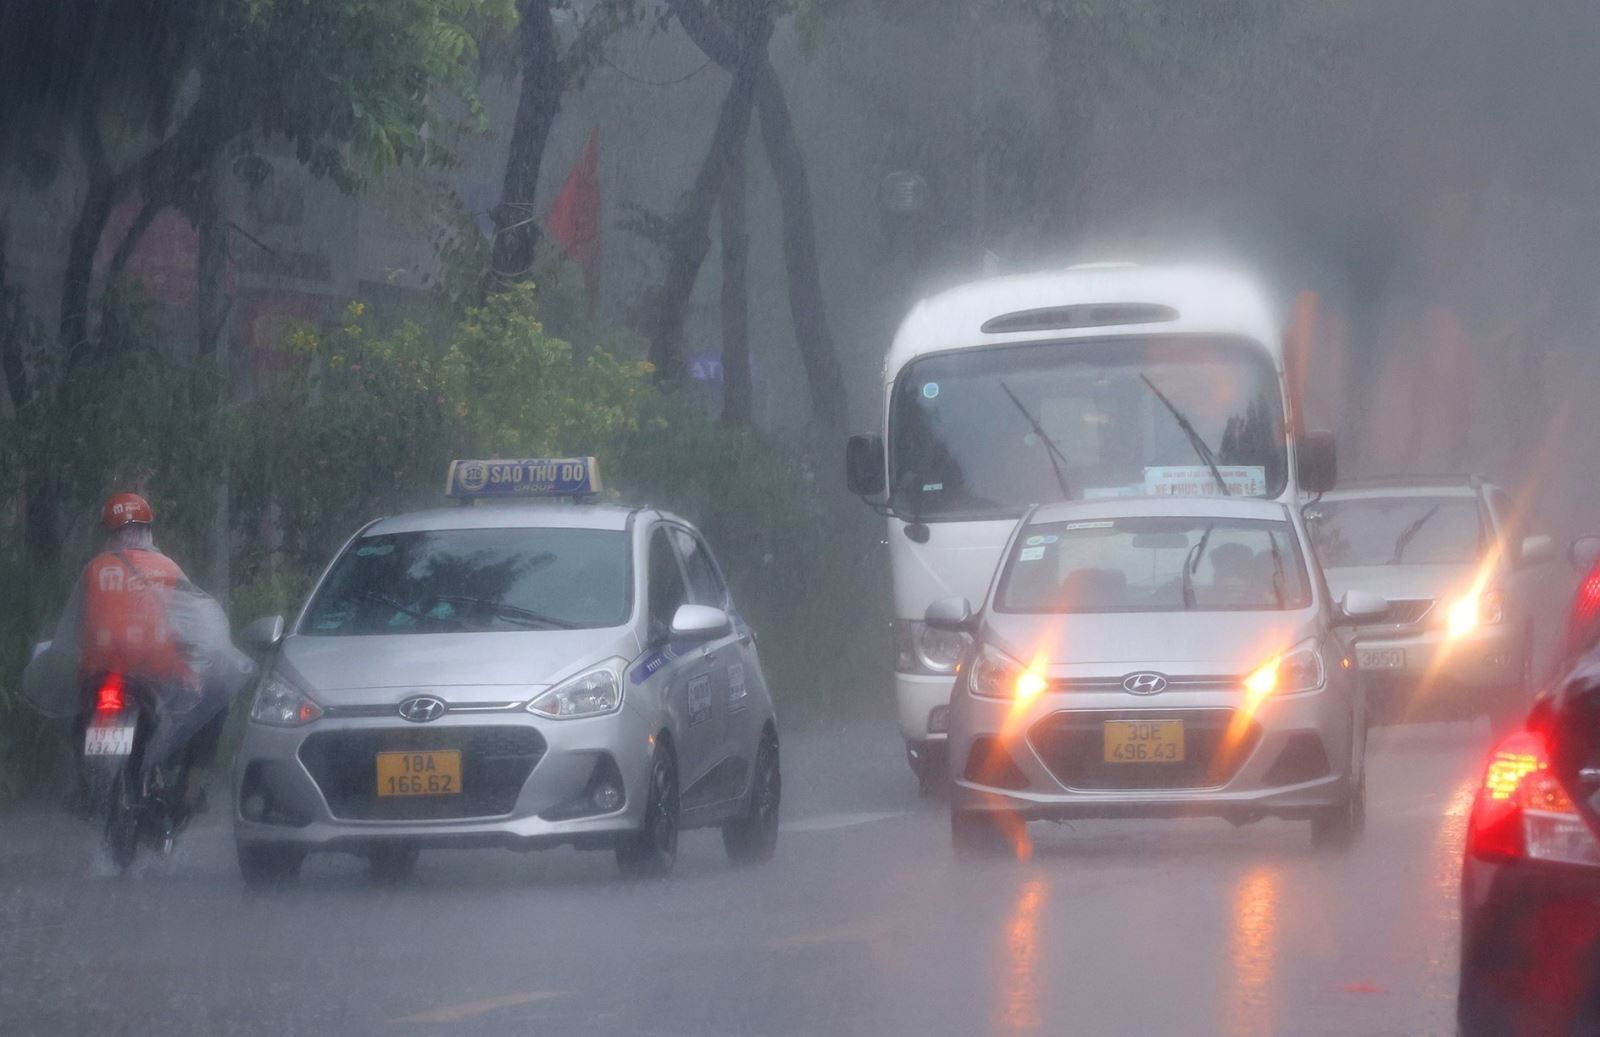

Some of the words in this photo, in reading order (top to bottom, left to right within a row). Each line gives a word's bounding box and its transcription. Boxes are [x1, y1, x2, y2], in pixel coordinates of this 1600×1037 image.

[491, 465, 522, 483] SAO
[1127, 723, 1162, 741] 30E
[402, 753, 436, 773] 18A
[387, 774, 452, 794] 166.62
